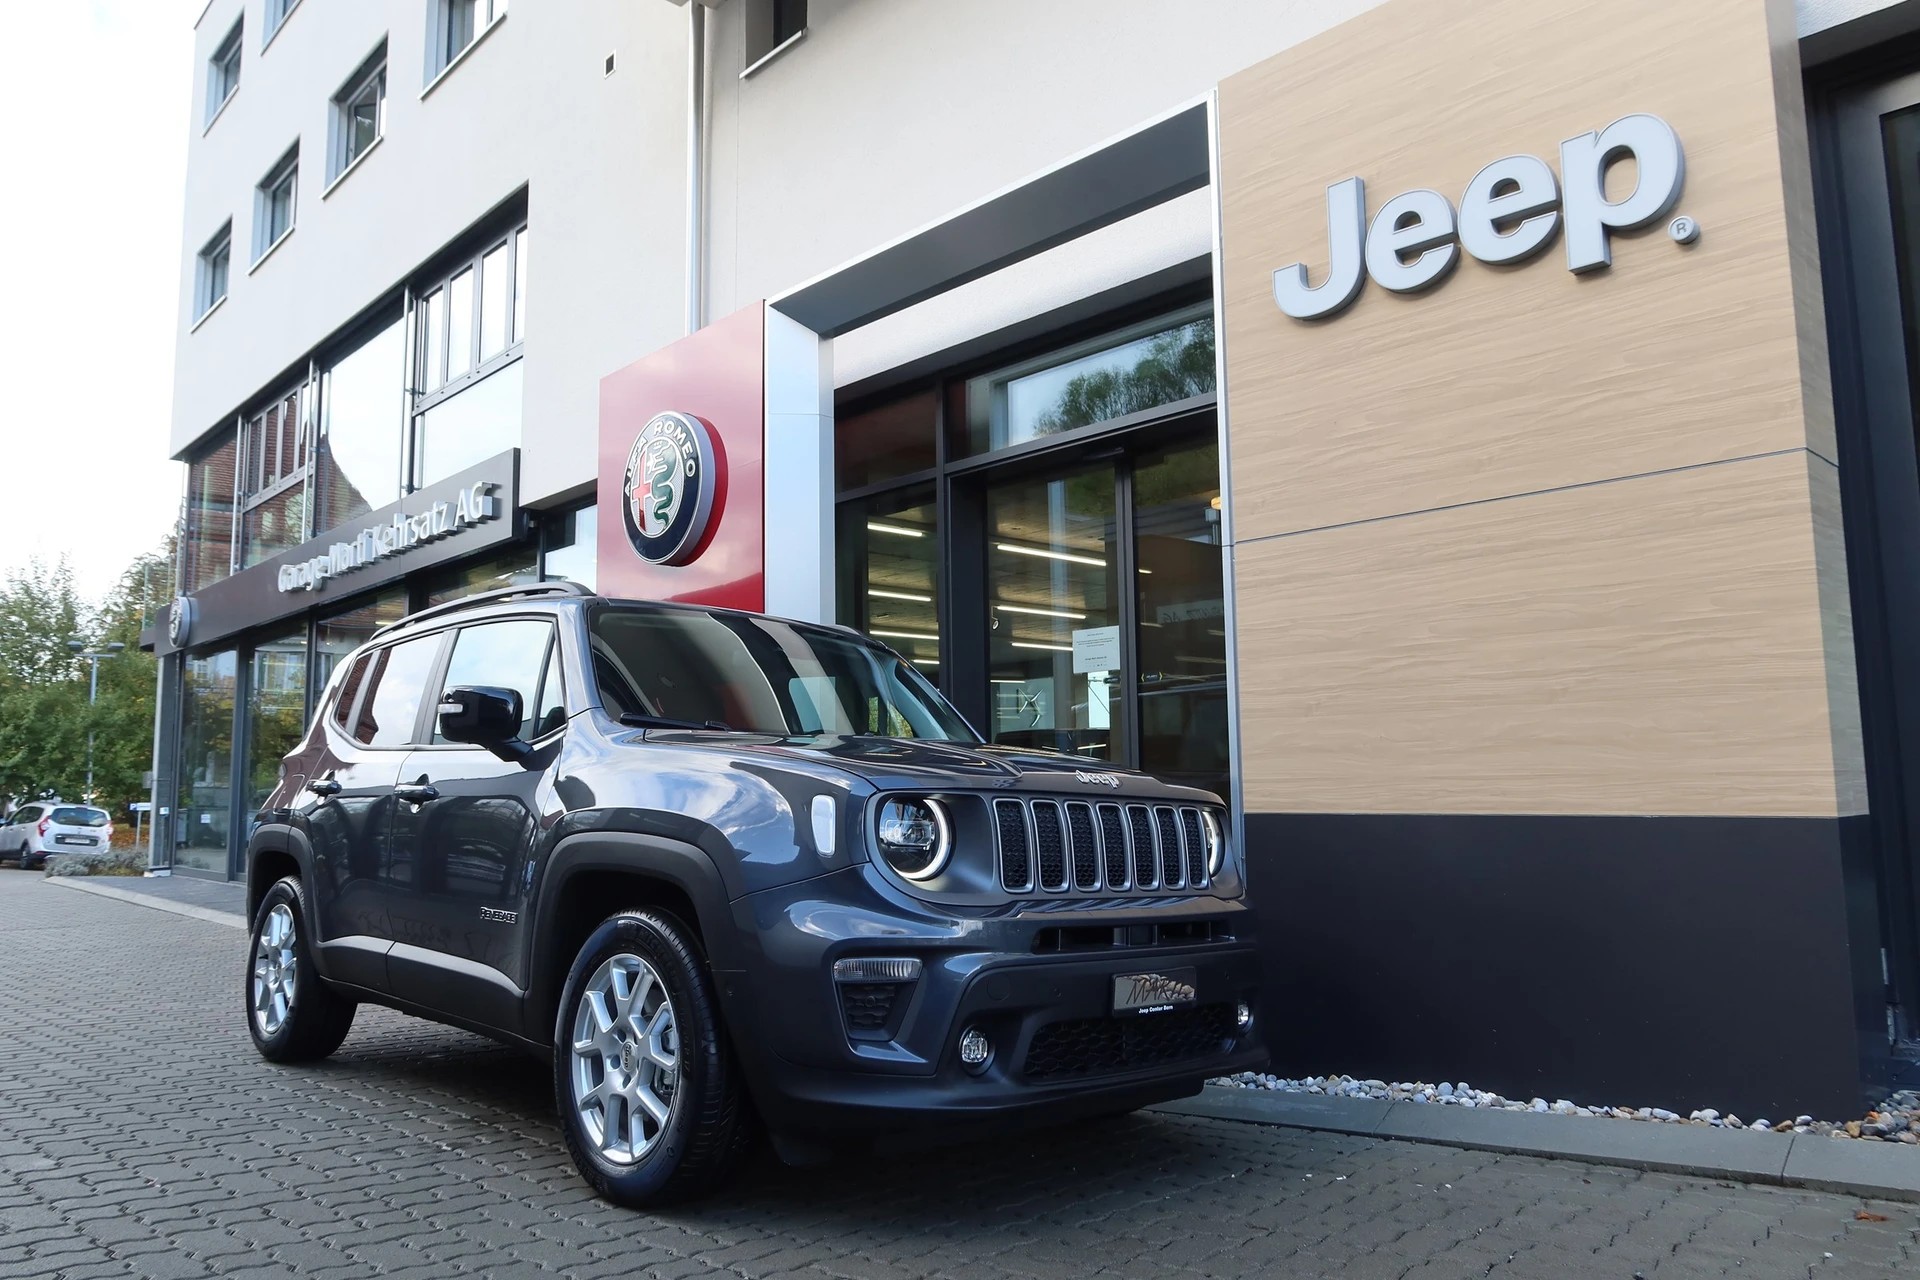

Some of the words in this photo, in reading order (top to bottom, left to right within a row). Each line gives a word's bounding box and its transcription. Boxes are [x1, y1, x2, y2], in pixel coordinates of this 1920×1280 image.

[1272, 112, 1687, 321] Jeep
[624, 436, 650, 498] ALFA
[653, 419, 697, 478] ROMEO
[278, 554, 331, 593] Garage
[453, 480, 493, 528] AG
[1075, 769, 1120, 790] Jeep
